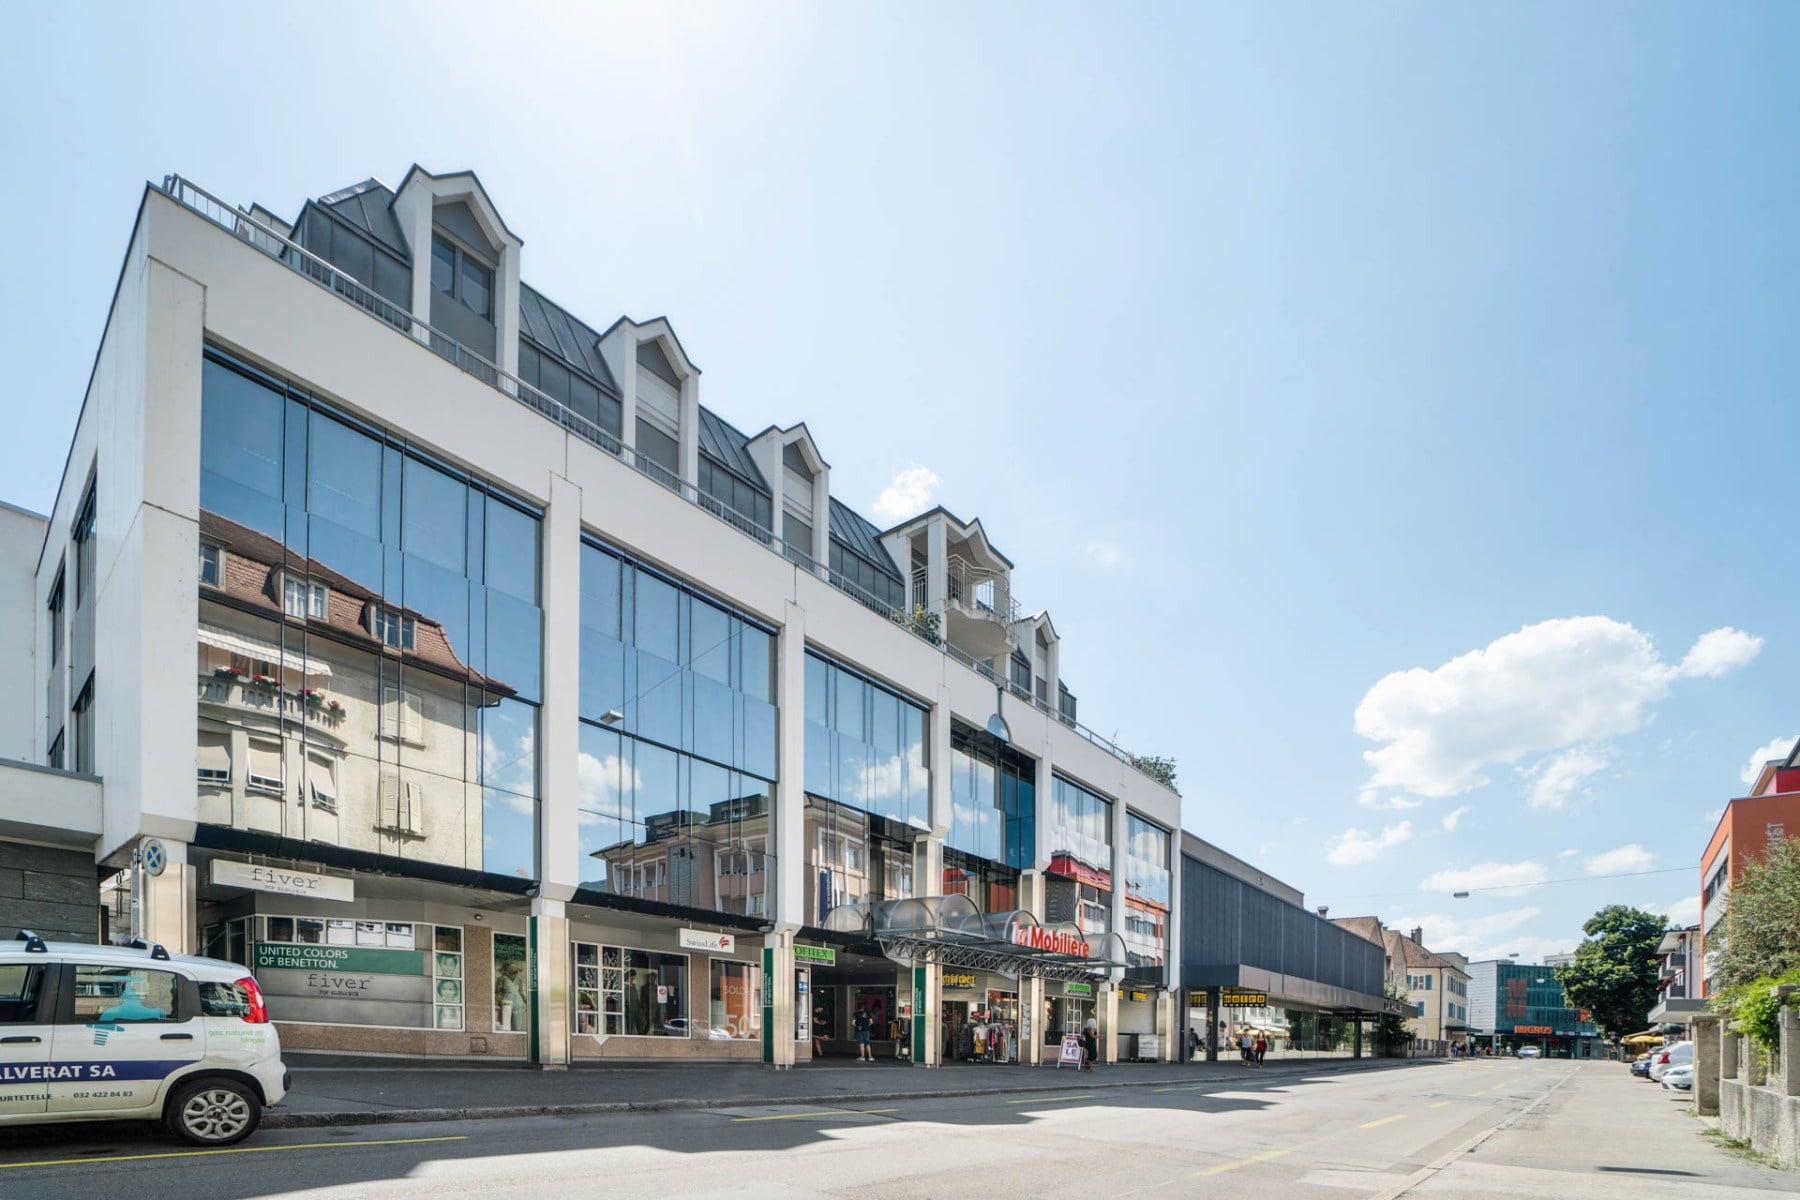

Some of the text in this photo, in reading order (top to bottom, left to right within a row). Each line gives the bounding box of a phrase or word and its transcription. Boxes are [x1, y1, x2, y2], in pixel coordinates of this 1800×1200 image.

[250, 867, 319, 889] fiver
[1031, 925, 1090, 959] Mobilière
[259, 945, 349, 959] UNITED COLORS
[259, 956, 275, 966] OF
[307, 973, 371, 990] fiver
[1514, 1025, 1553, 1034] MIGROS
[0, 1065, 116, 1080] LVERAT SA
